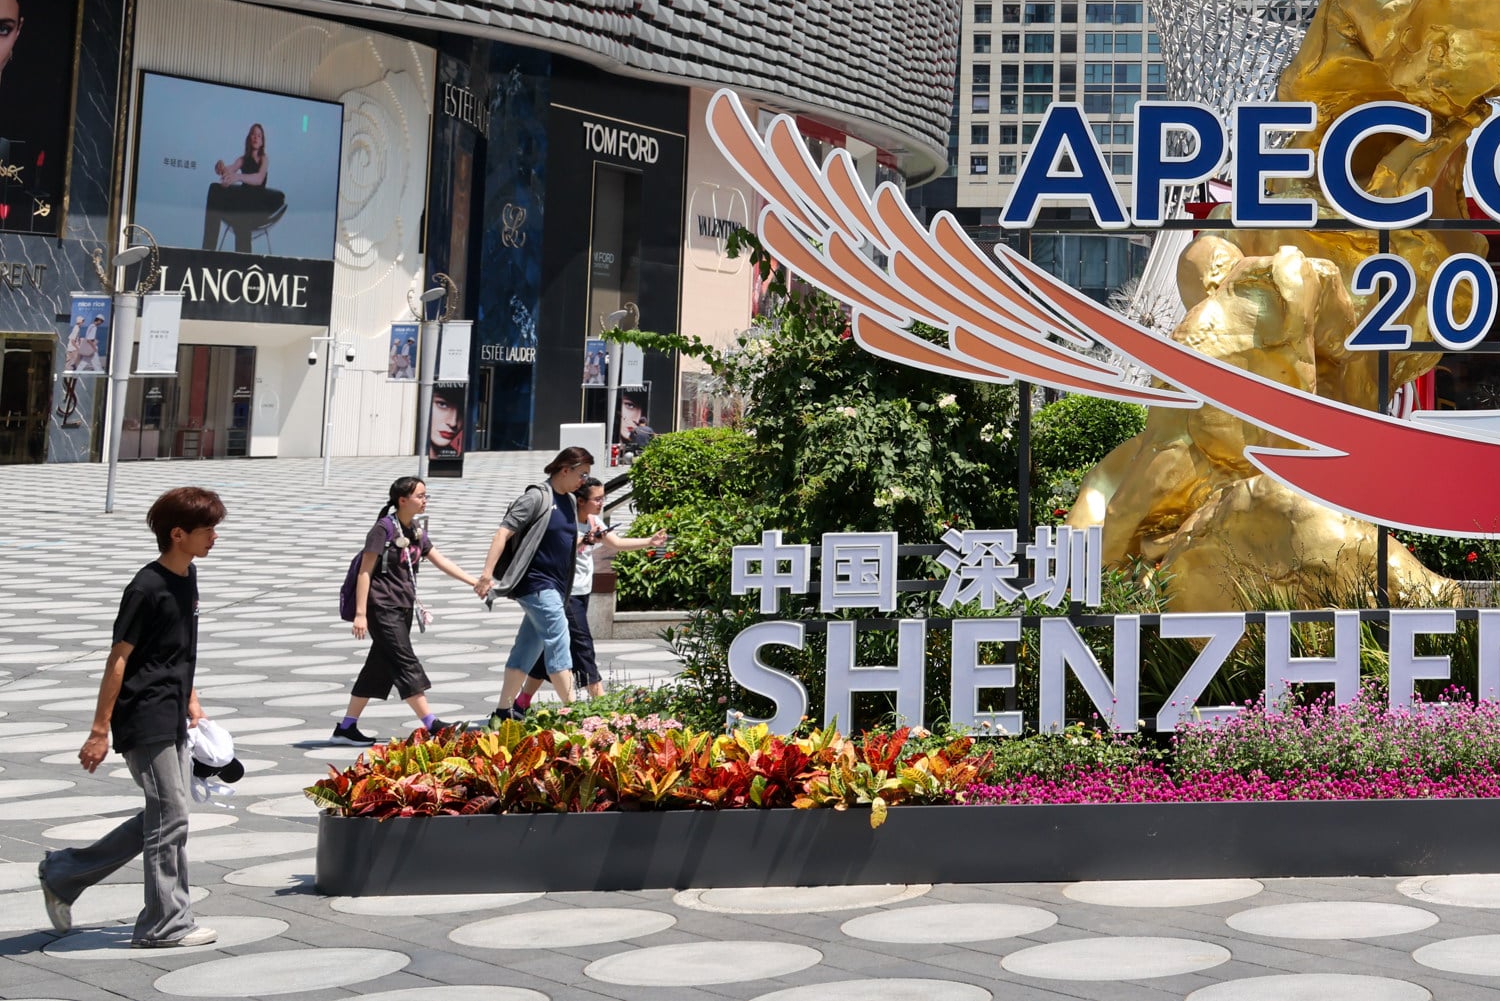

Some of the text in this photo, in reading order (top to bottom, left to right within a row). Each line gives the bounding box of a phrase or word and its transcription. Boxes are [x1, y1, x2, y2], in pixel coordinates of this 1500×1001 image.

[582, 121, 660, 164] TOM FORD
[998, 100, 1433, 229] APEC
[481, 344, 505, 361] ESTÉE
[505, 346, 536, 362] LAUDER
[731, 526, 1103, 614] 中国 深圳
